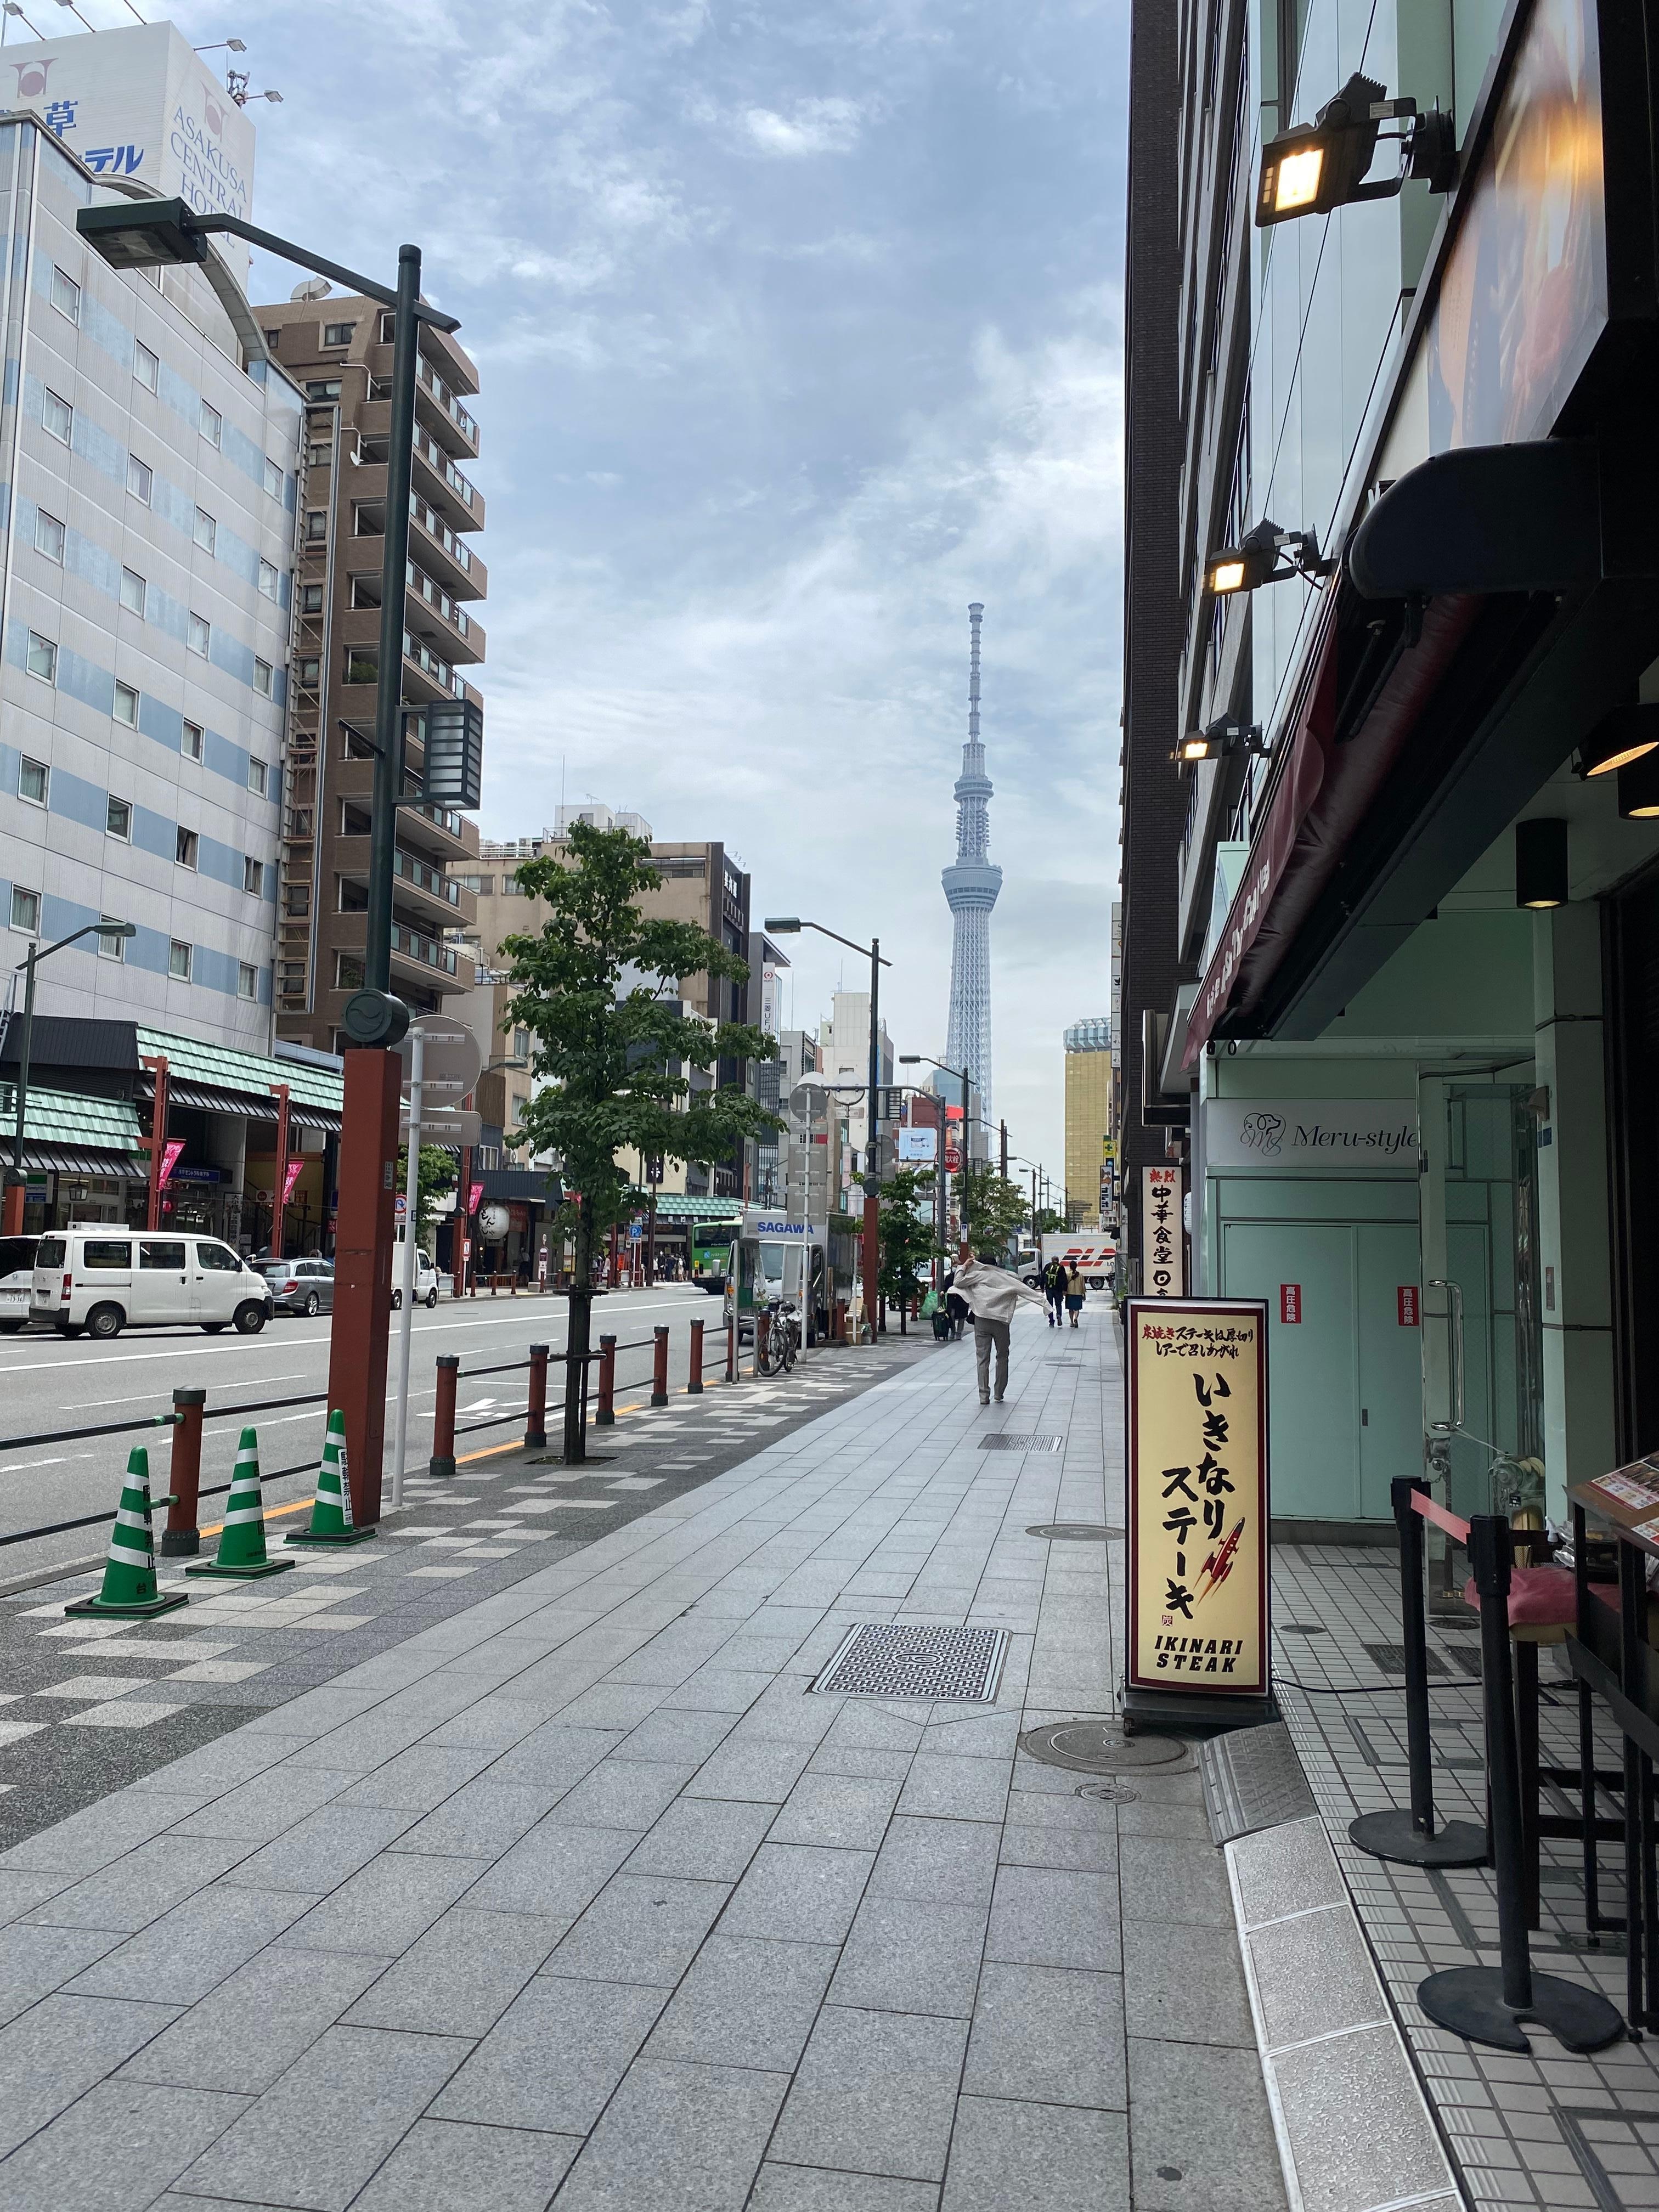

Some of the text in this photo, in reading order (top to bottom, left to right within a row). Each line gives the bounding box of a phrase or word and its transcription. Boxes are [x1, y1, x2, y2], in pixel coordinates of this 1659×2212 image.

[43, 100, 78, 137] 草
[78, 145, 144, 174] テル
[174, 105, 247, 203] ASAKUSA
[171, 132, 243, 220] CENTRAL
[180, 172, 235, 249] HOTL
[1291, 1125, 1418, 1155] Meru-style
[1149, 1168, 1176, 1183] 熱烈
[757, 1221, 814, 1234] SAGAWA
[1286, 1286, 1296, 1322] 高圧危険
[1403, 1289, 1414, 1325] 高圧危険
[1142, 1324, 1254, 1342] 炭焼きステーキは厚切り
[1193, 1372, 1235, 1540] いきなり
[1161, 1466, 1200, 1620] ステーキ
[1154, 1635, 1243, 1655] IKINARI
[1156, 1653, 1237, 1673] STEAK
